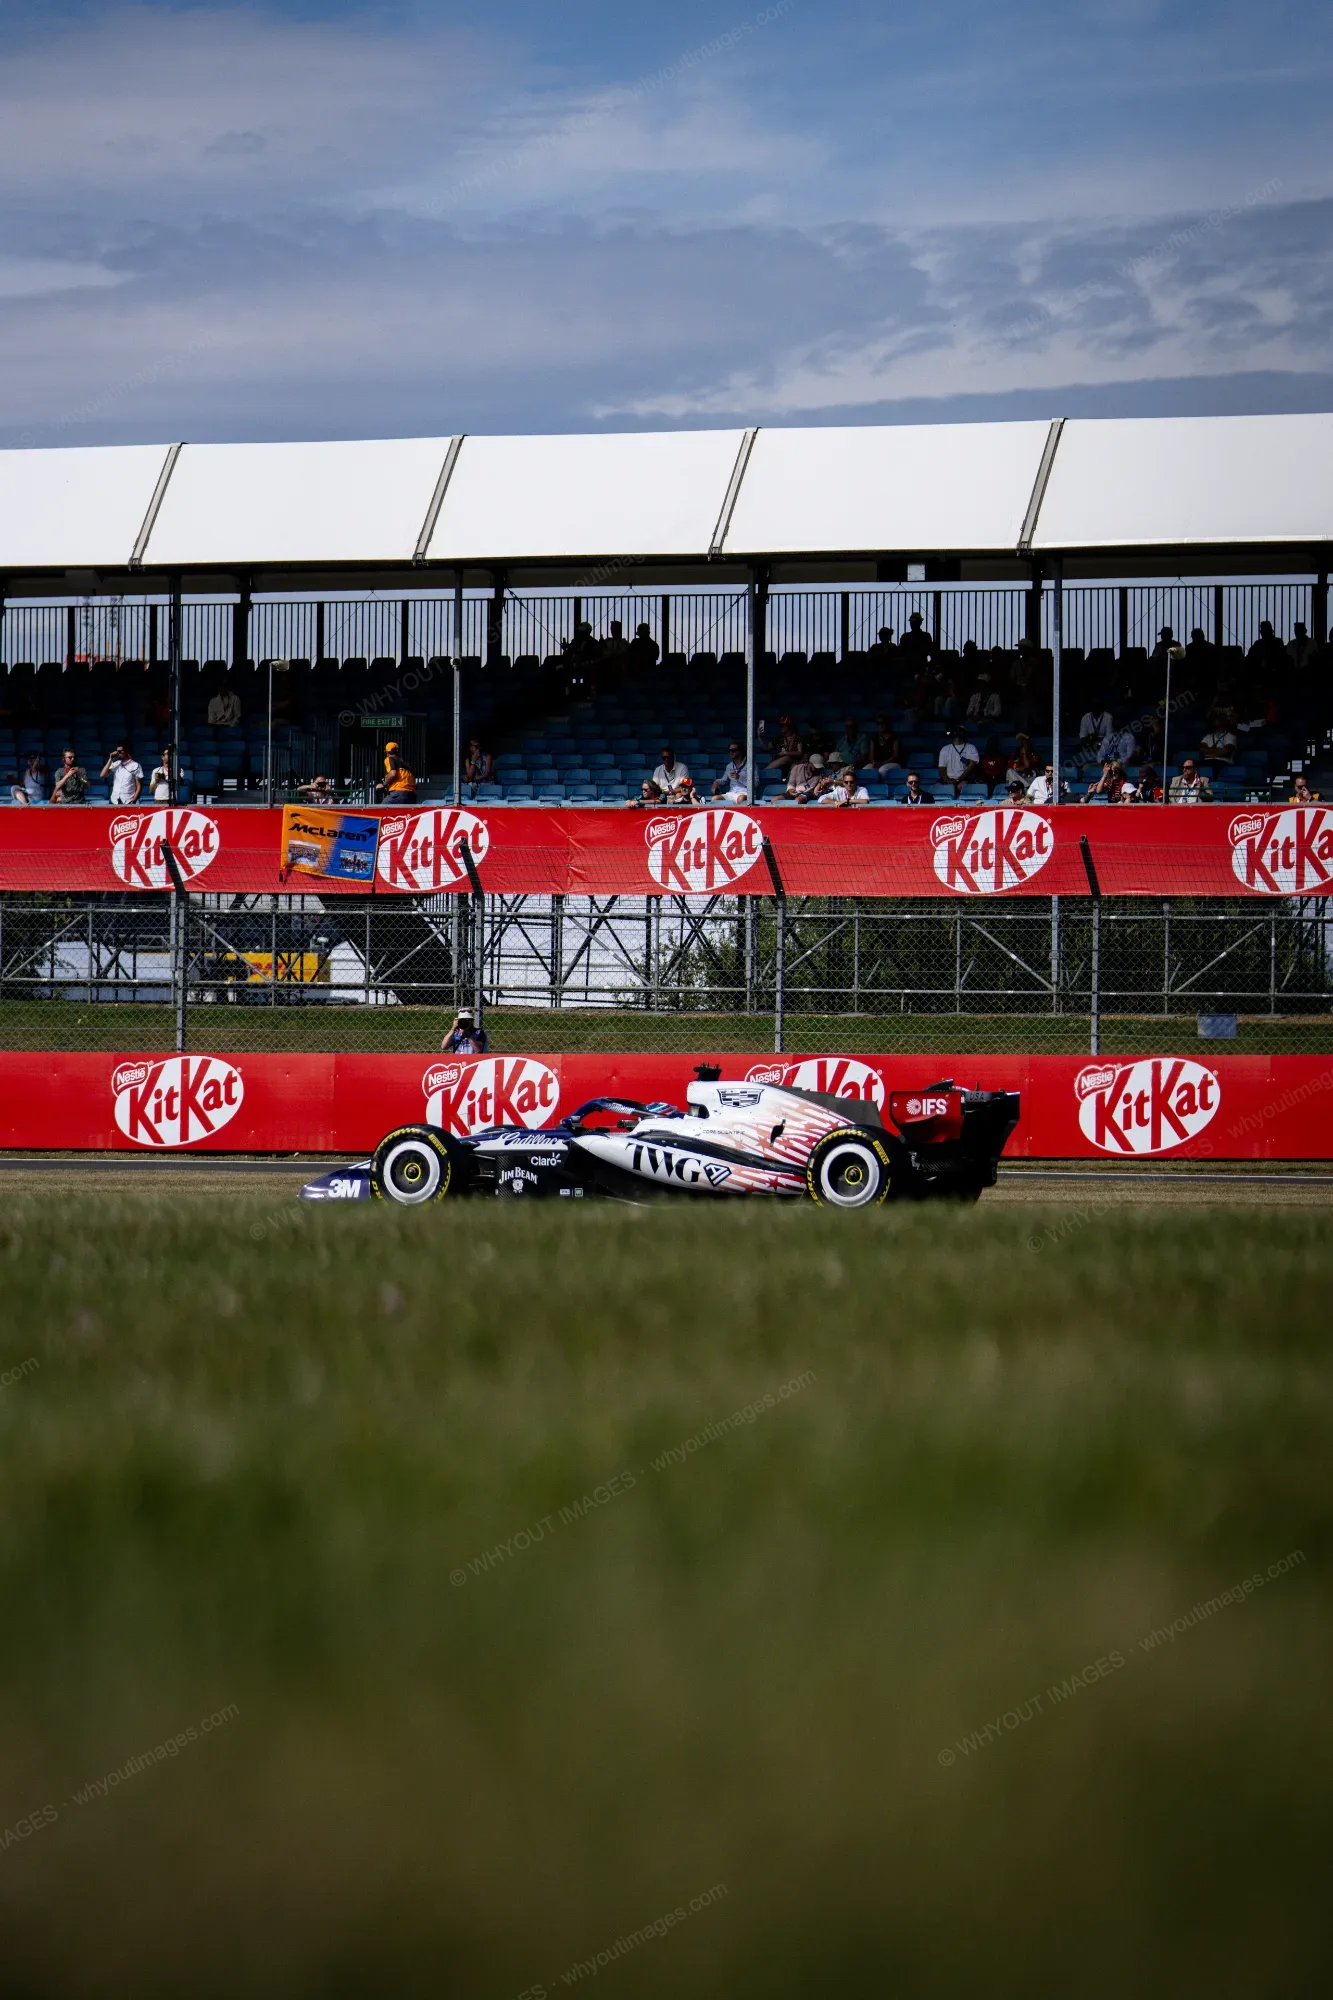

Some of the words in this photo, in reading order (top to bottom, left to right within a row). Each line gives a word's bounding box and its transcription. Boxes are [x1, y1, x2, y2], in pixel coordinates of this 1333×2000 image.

[362, 718, 375, 726] FIRE
[377, 718, 390, 726] EXIT
[124, 811, 214, 887] KitKat
[288, 823, 367, 842] McLaren
[390, 811, 483, 889] KitKat
[661, 811, 757, 891] KitKat
[947, 811, 1048, 892] KitKat
[1246, 810, 1333, 892] KitKa
[129, 1058, 237, 1144] KitKat
[442, 1059, 553, 1136] KitKat
[922, 1098, 946, 1115] IFS
[969, 1092, 984, 1100] USA
[1096, 1060, 1214, 1151] KitKat
[504, 1132, 559, 1146] Cadillac
[498, 1170, 514, 1184] JIM
[515, 1166, 538, 1185] BEAM
[530, 1154, 558, 1166] Claro
[625, 1142, 701, 1182] TWG
[328, 1179, 360, 1198] 3M
